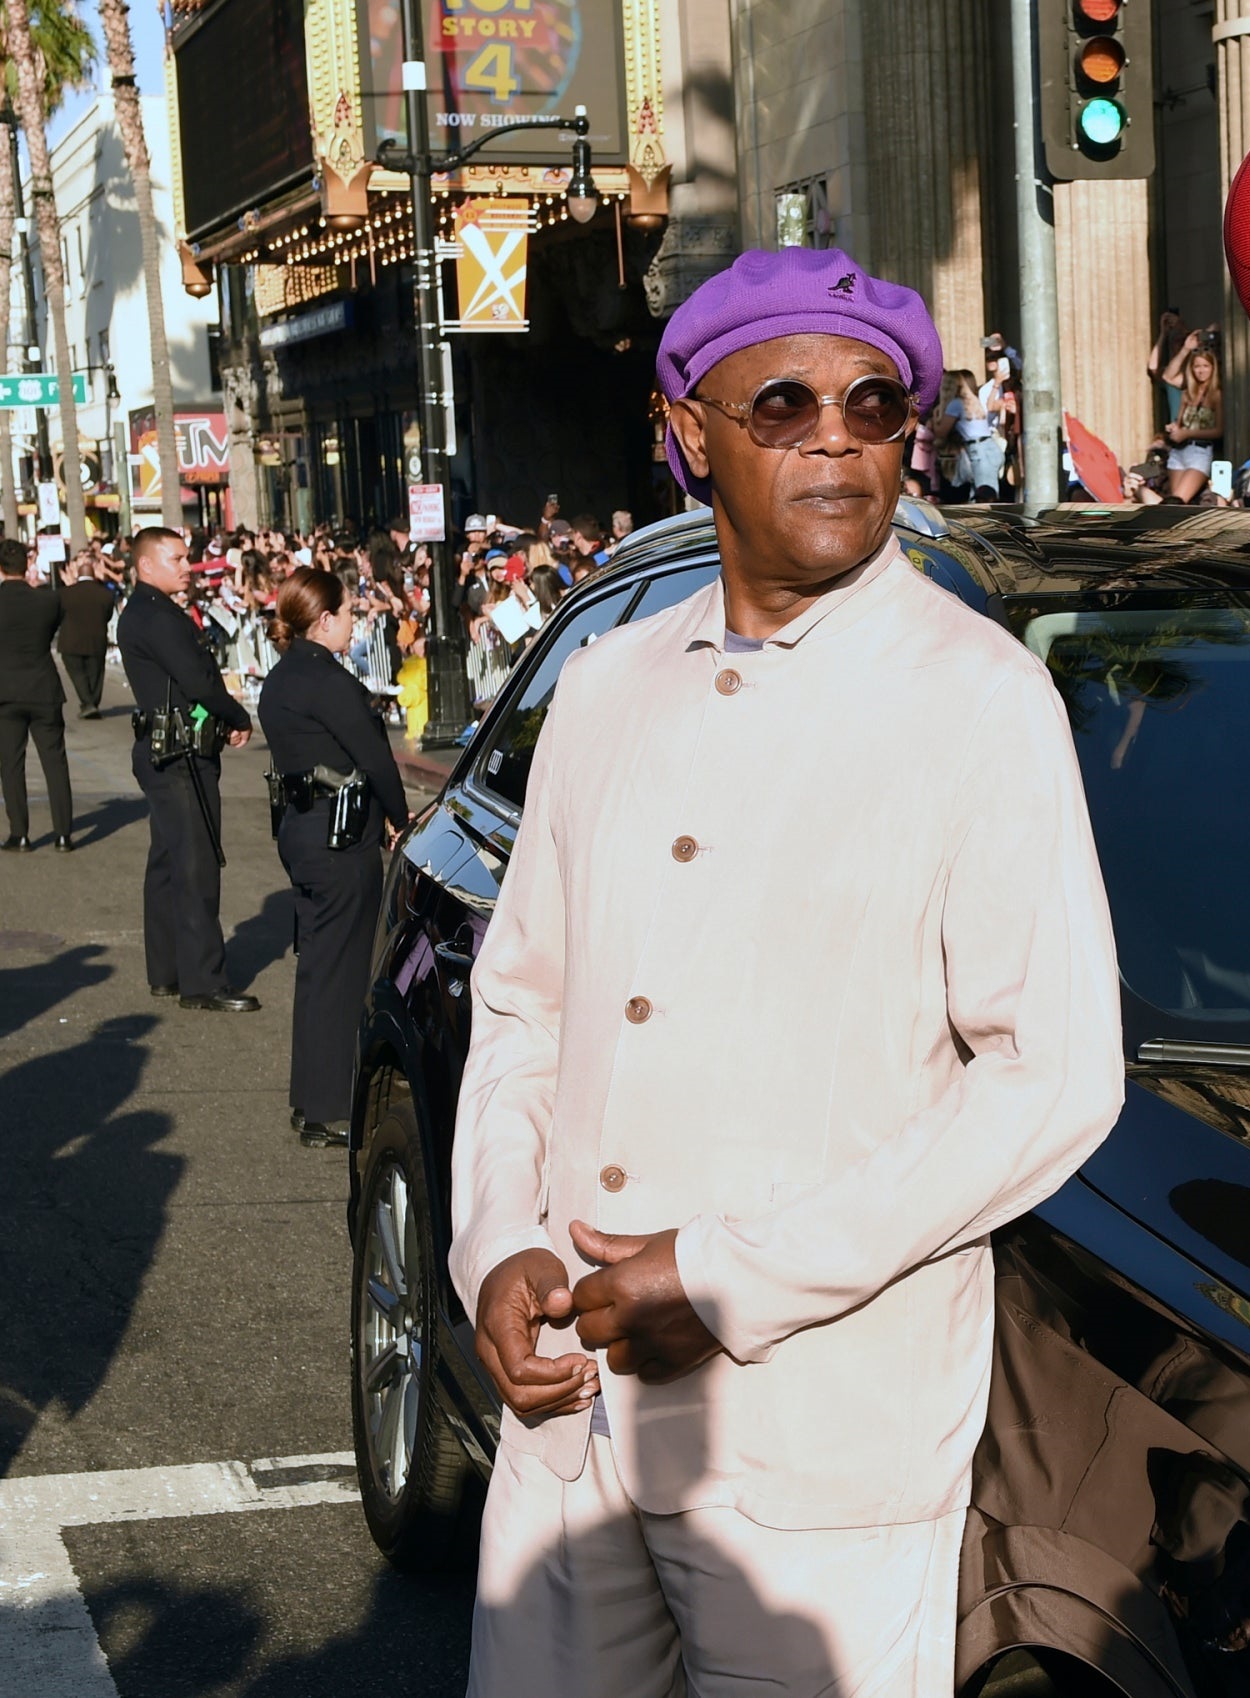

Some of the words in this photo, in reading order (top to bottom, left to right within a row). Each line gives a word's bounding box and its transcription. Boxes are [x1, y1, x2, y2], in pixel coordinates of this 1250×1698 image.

[441, 16, 537, 38] STORY
[463, 41, 519, 102] 4
[436, 112, 476, 127] NOW
